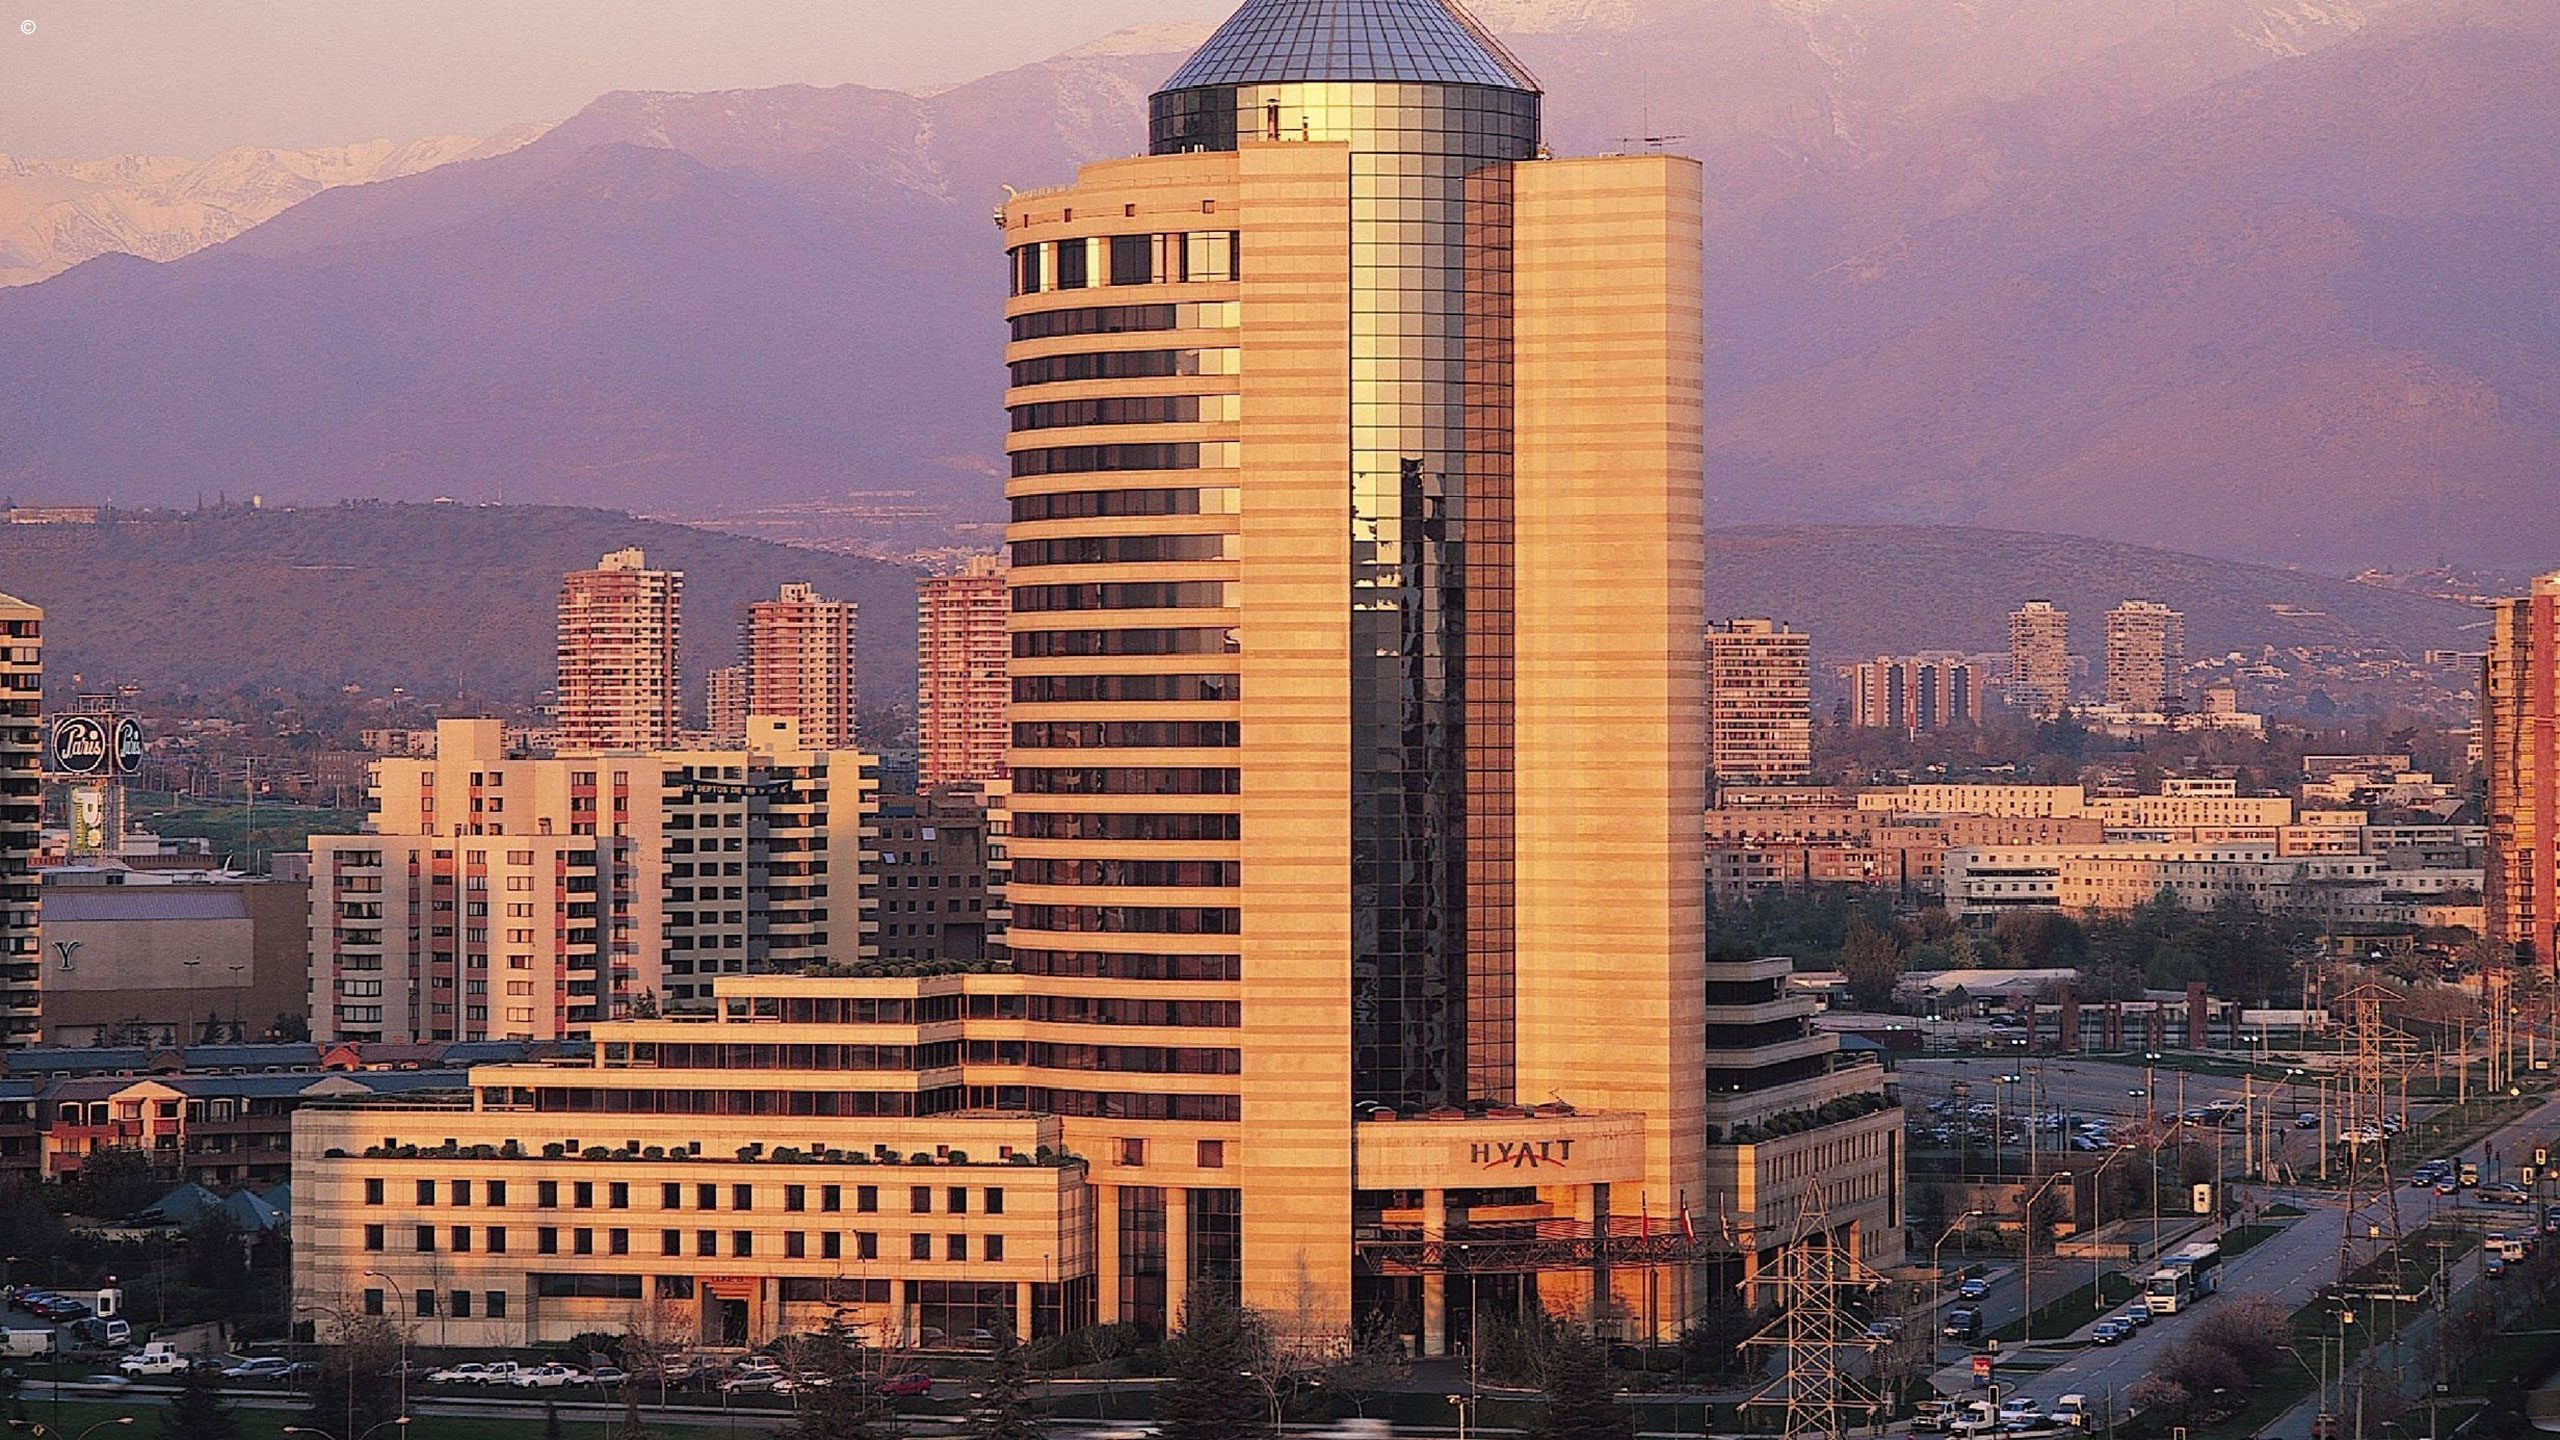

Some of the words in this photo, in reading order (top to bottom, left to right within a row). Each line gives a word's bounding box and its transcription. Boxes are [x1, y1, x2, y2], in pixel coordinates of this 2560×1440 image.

[61, 724, 102, 759] Paris
[119, 724, 141, 758] Paris
[52, 940, 83, 970] Y
[1471, 1139, 1575, 1168] HYATT
